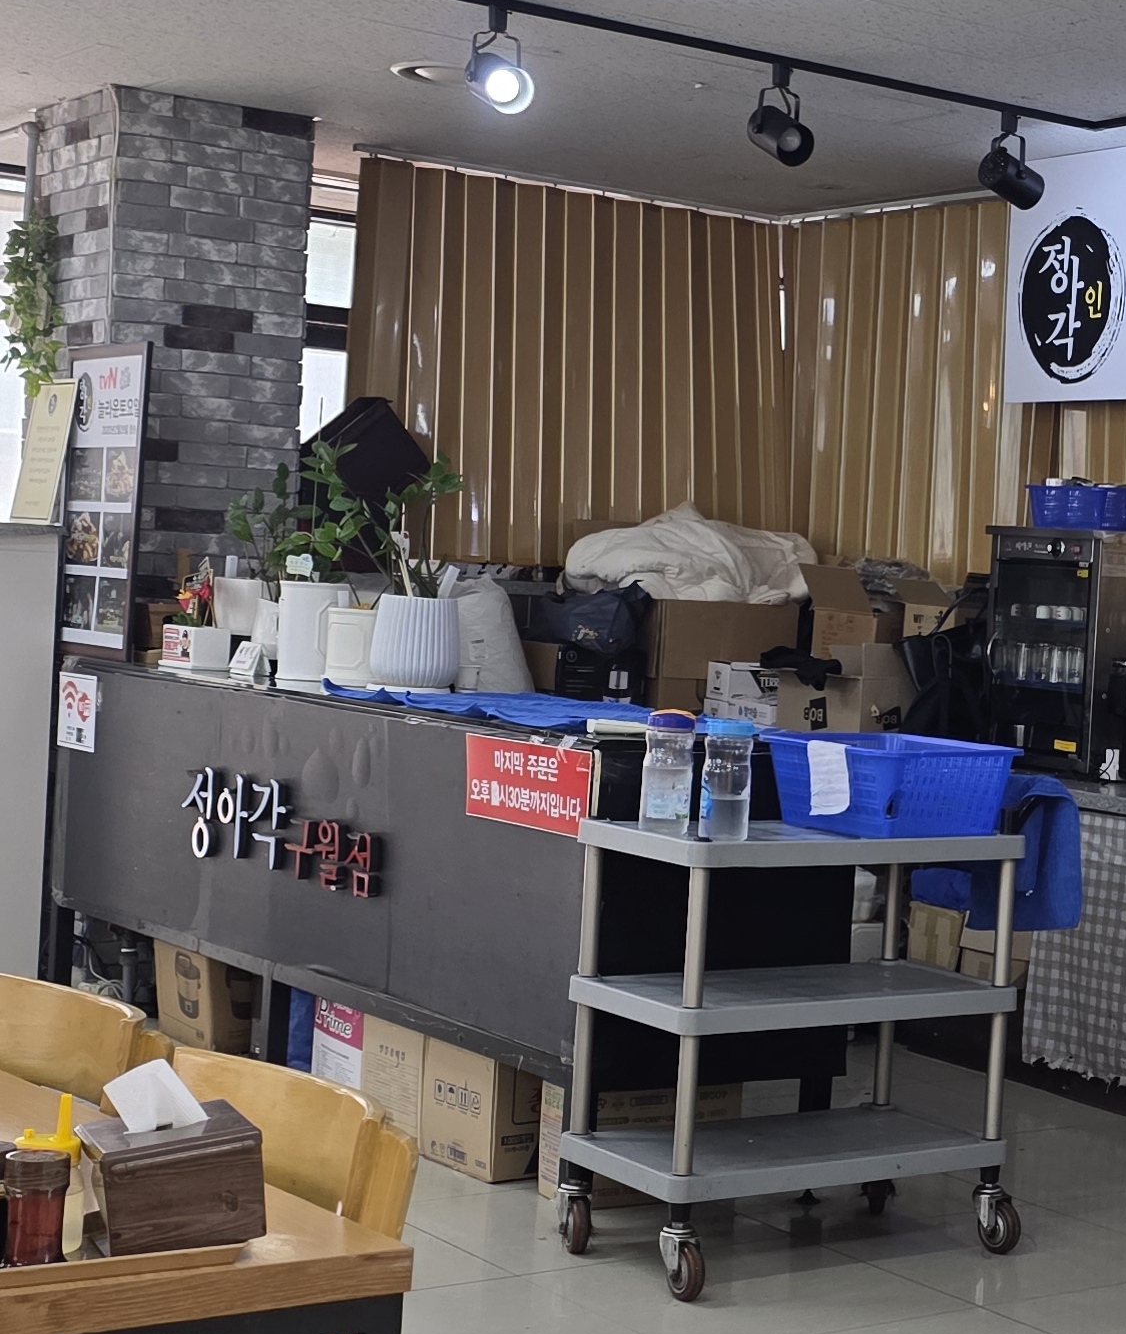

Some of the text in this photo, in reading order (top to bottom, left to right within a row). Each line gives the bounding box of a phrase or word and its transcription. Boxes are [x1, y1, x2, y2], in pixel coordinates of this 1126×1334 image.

[494, 749, 559, 782] 마지막 주문은
[471, 779, 581, 823] 오후 시30분까지입니다
[315, 995, 353, 1039] Prime
